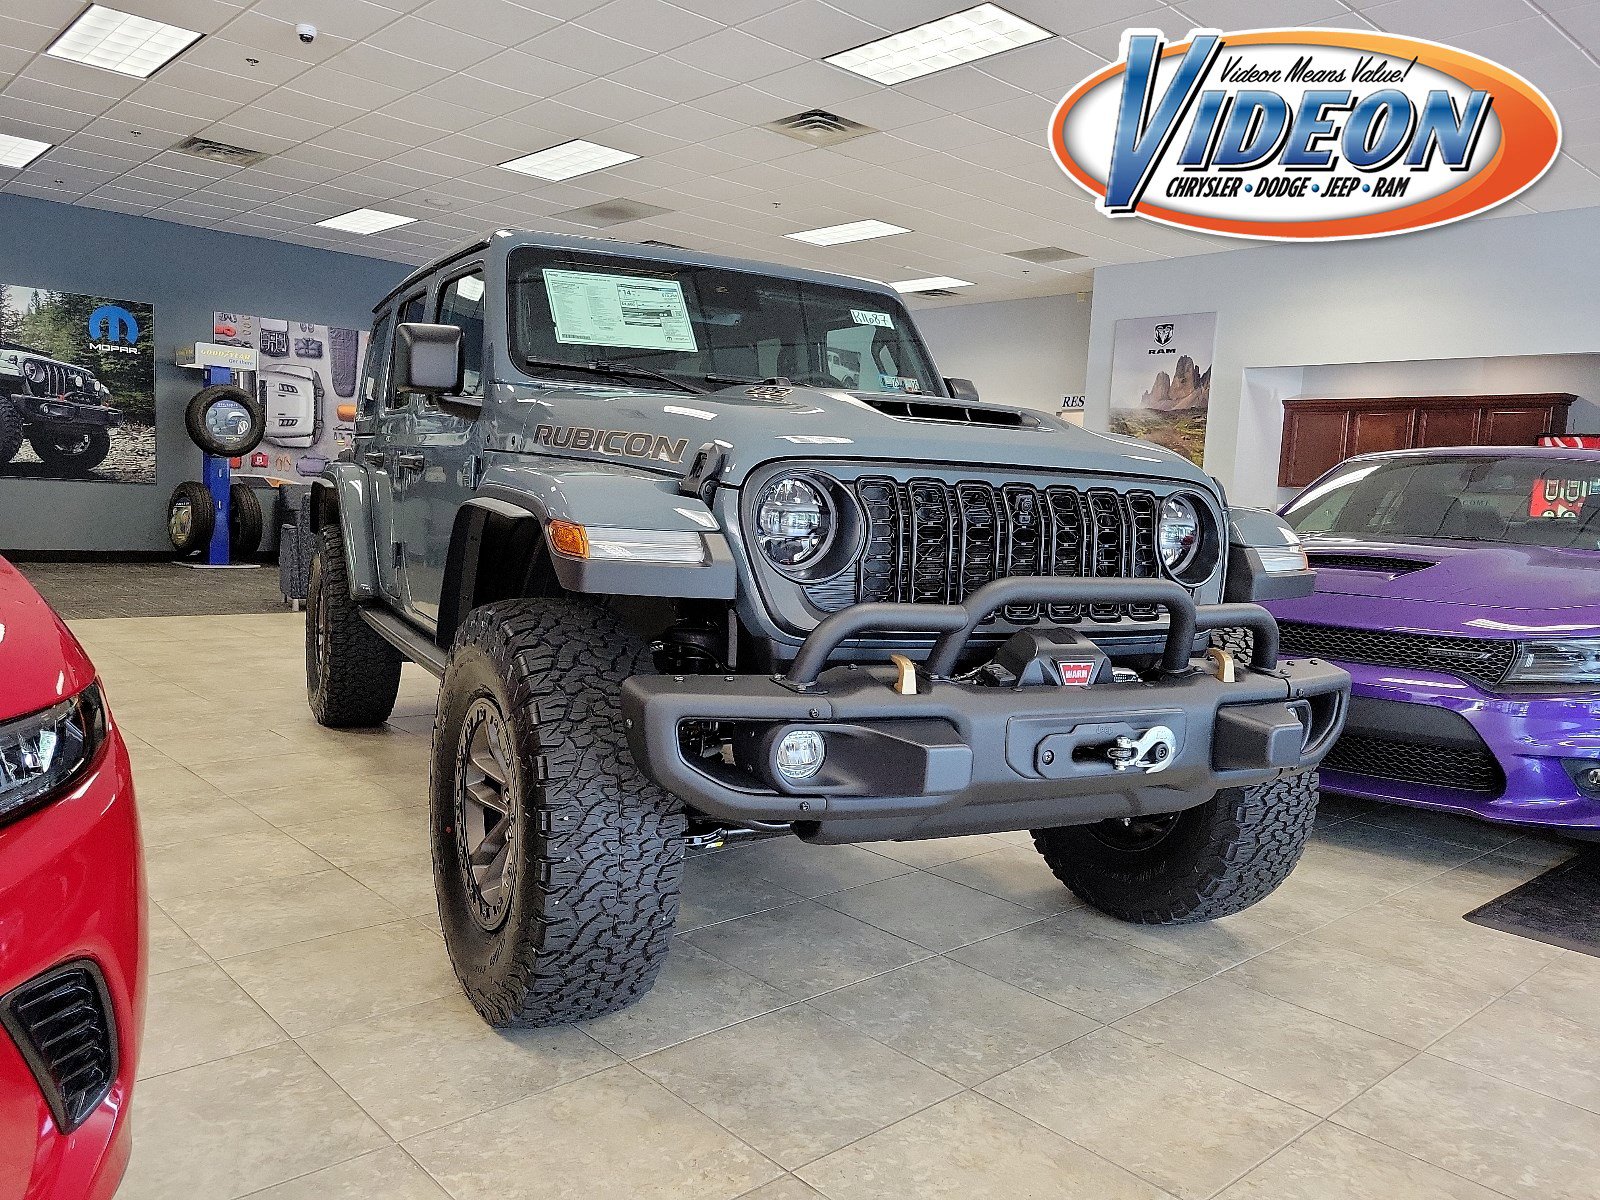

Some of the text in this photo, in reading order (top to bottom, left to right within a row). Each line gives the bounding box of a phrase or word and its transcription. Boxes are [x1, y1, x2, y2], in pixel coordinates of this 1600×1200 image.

[201, 348, 252, 361] GOODYEAR
[533, 423, 690, 463] RUBICON
[1065, 669, 1088, 679] WARN
[1096, 725, 1113, 735] Jeep
